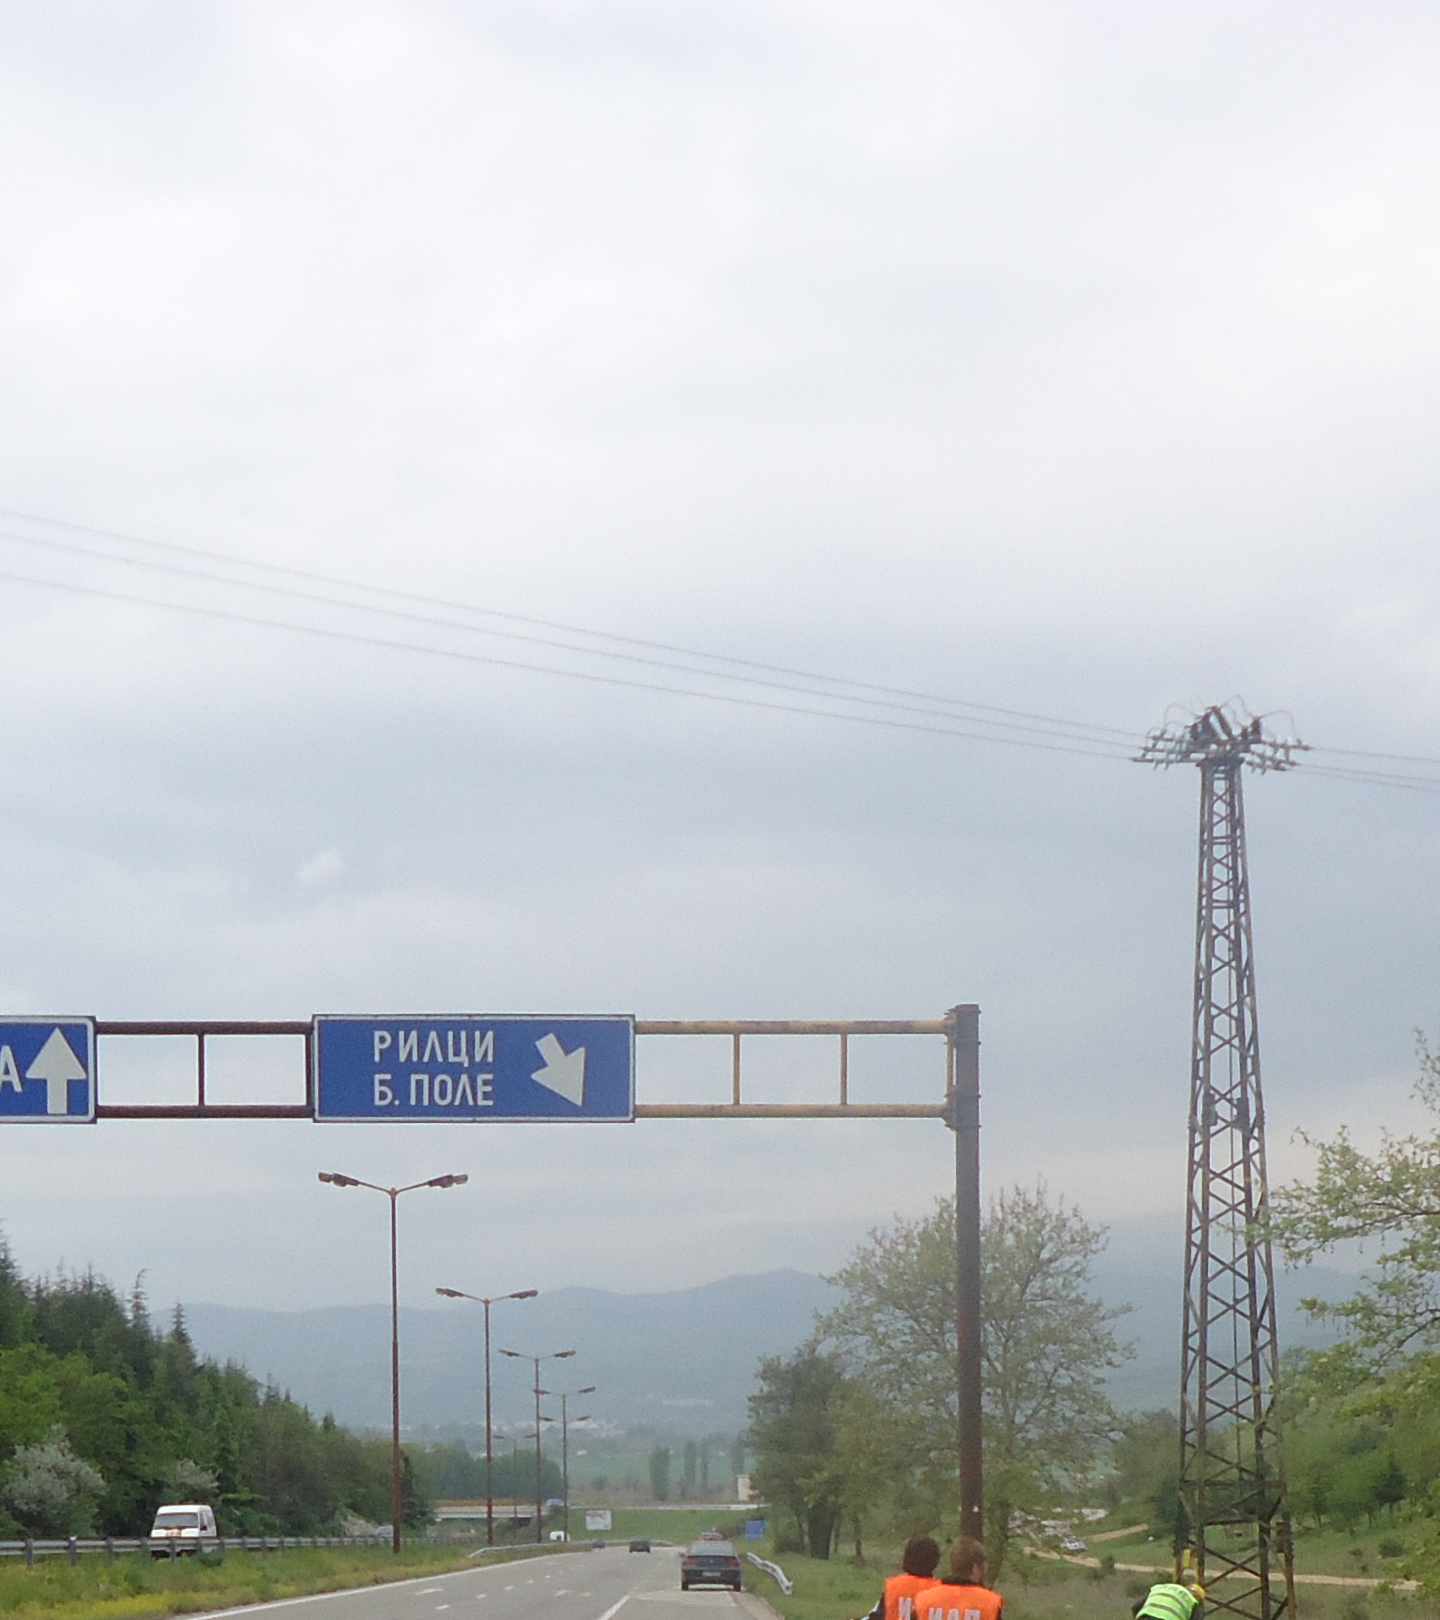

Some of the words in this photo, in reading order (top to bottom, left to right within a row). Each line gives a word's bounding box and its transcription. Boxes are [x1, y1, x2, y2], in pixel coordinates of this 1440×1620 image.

[374, 1030, 494, 1067] РИЛЦИ
[374, 1074, 400, 1106] Б.
[410, 1074, 494, 1106] ПОЛЕ
